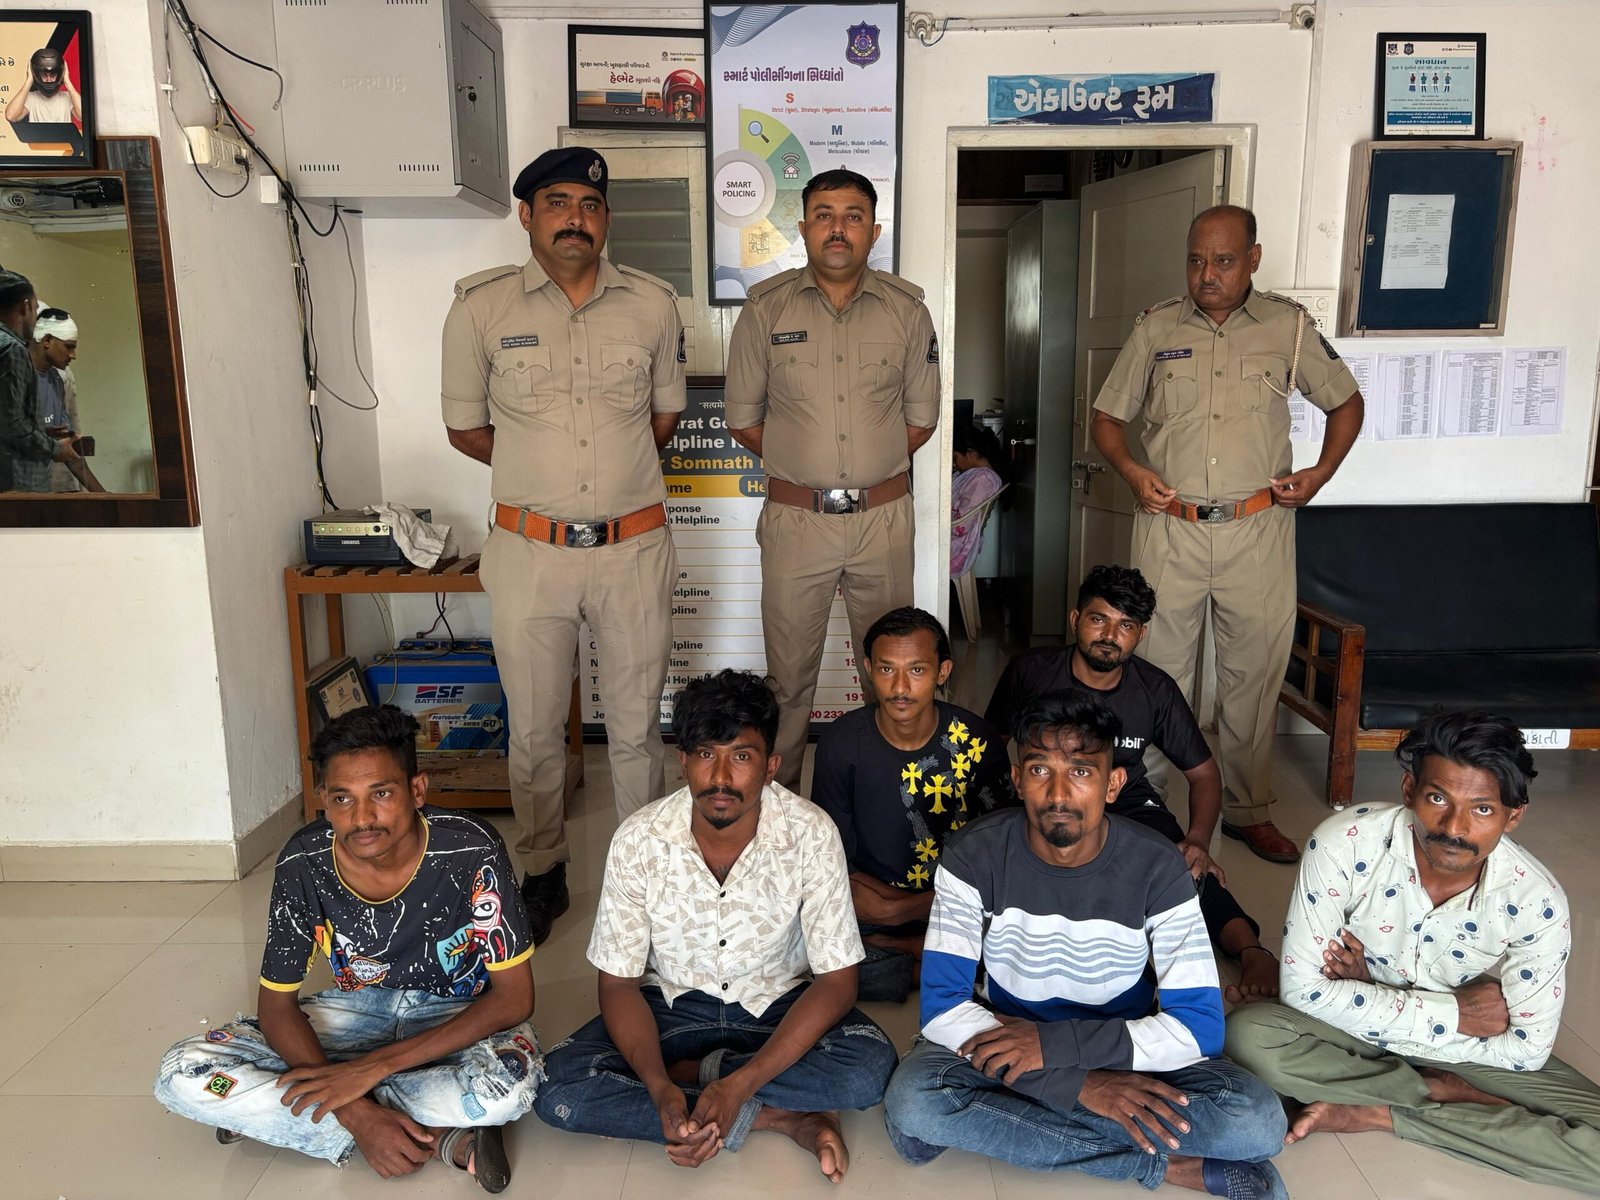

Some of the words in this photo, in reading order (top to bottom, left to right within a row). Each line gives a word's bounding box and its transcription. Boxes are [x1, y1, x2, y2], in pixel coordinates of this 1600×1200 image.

[723, 67, 749, 82] સ્માર્ટ
[786, 93, 795, 104] S
[1013, 78, 1122, 112] એકાઉન્ટ
[1132, 85, 1175, 119] રૂમ
[831, 125, 843, 136] M
[670, 455, 754, 470] Somnath
[675, 515, 720, 526] Helpline
[437, 685, 465, 699] SF
[483, 719, 496, 728] 60
